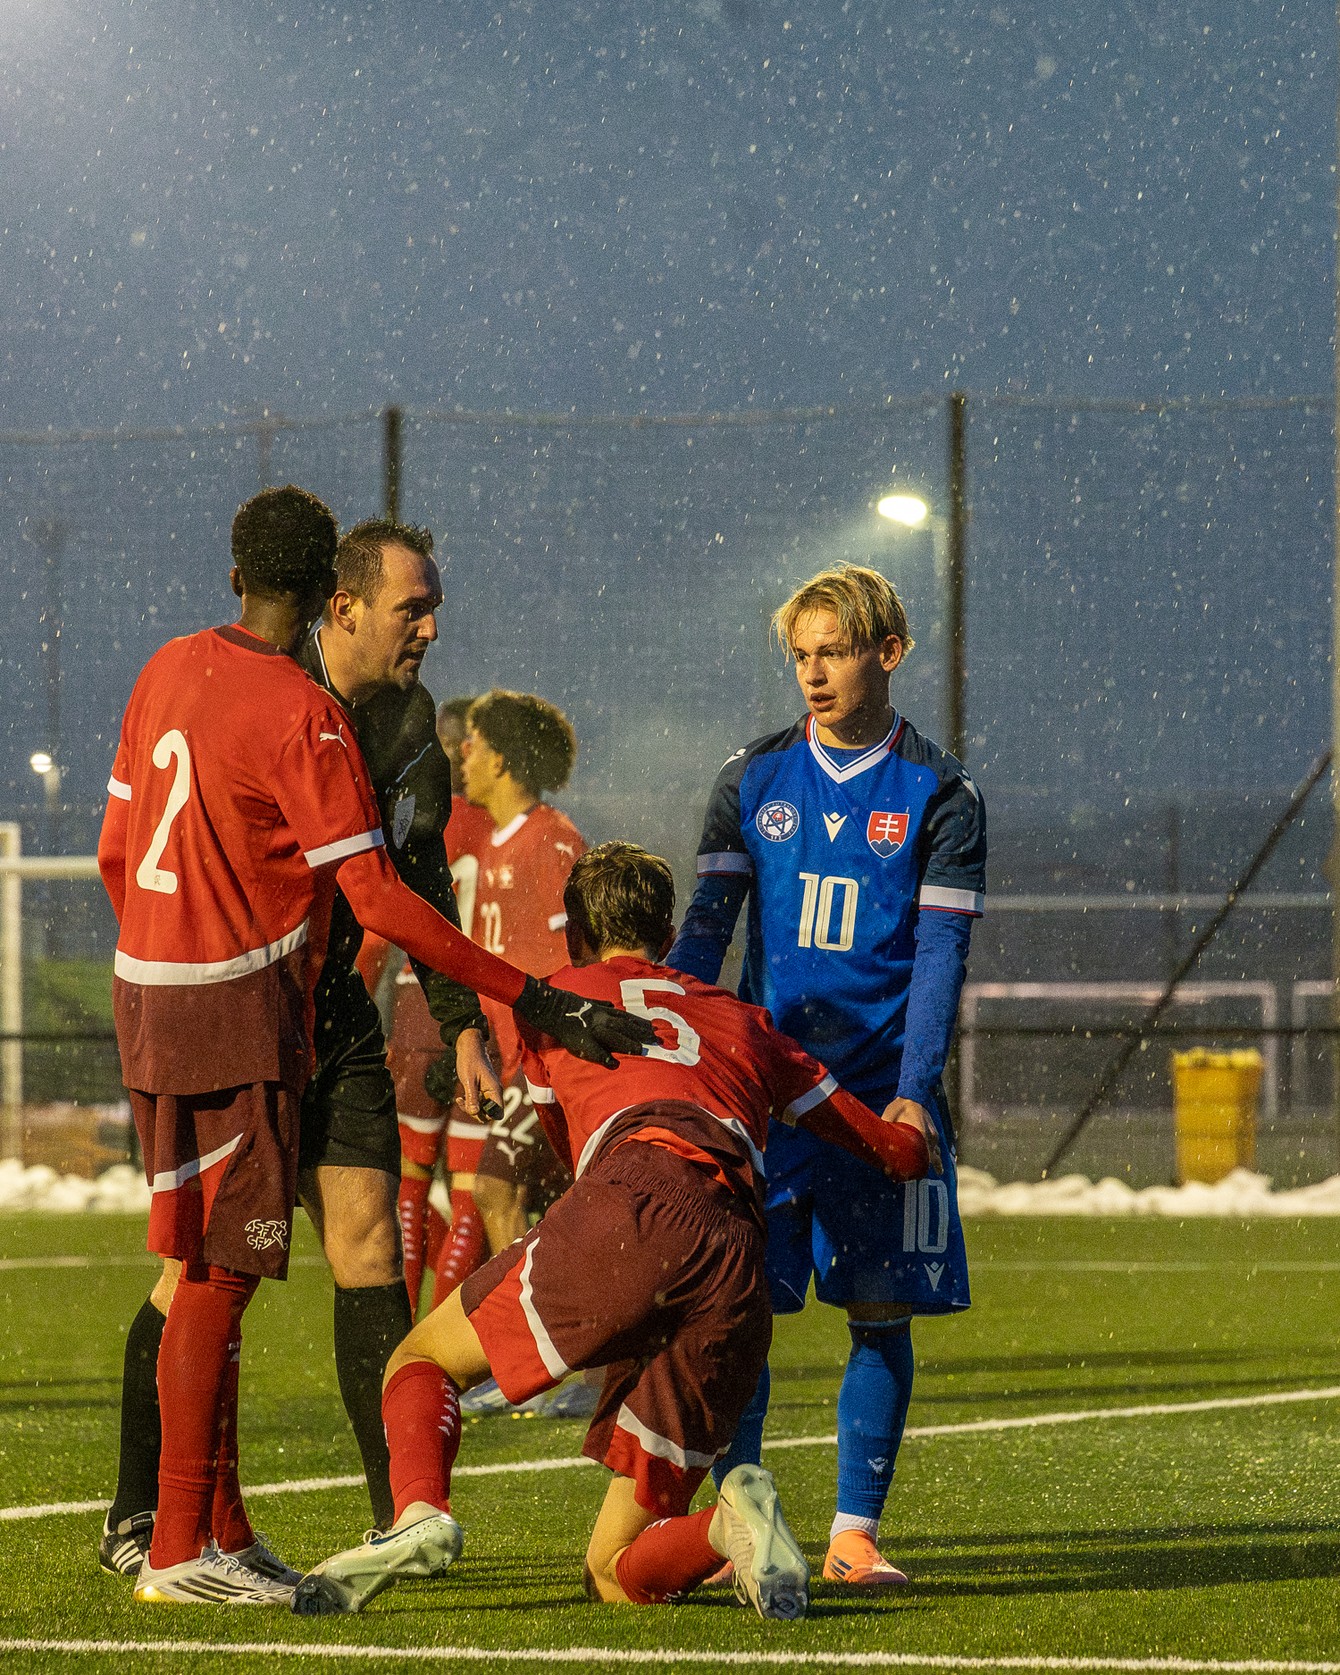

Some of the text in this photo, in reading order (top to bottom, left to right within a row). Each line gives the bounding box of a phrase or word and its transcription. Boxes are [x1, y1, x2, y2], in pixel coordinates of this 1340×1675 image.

[136, 729, 191, 895] 2
[798, 872, 859, 952] 10
[619, 978, 701, 1067] 5
[491, 1086, 539, 1145] 22
[902, 1179, 949, 1253] 10
